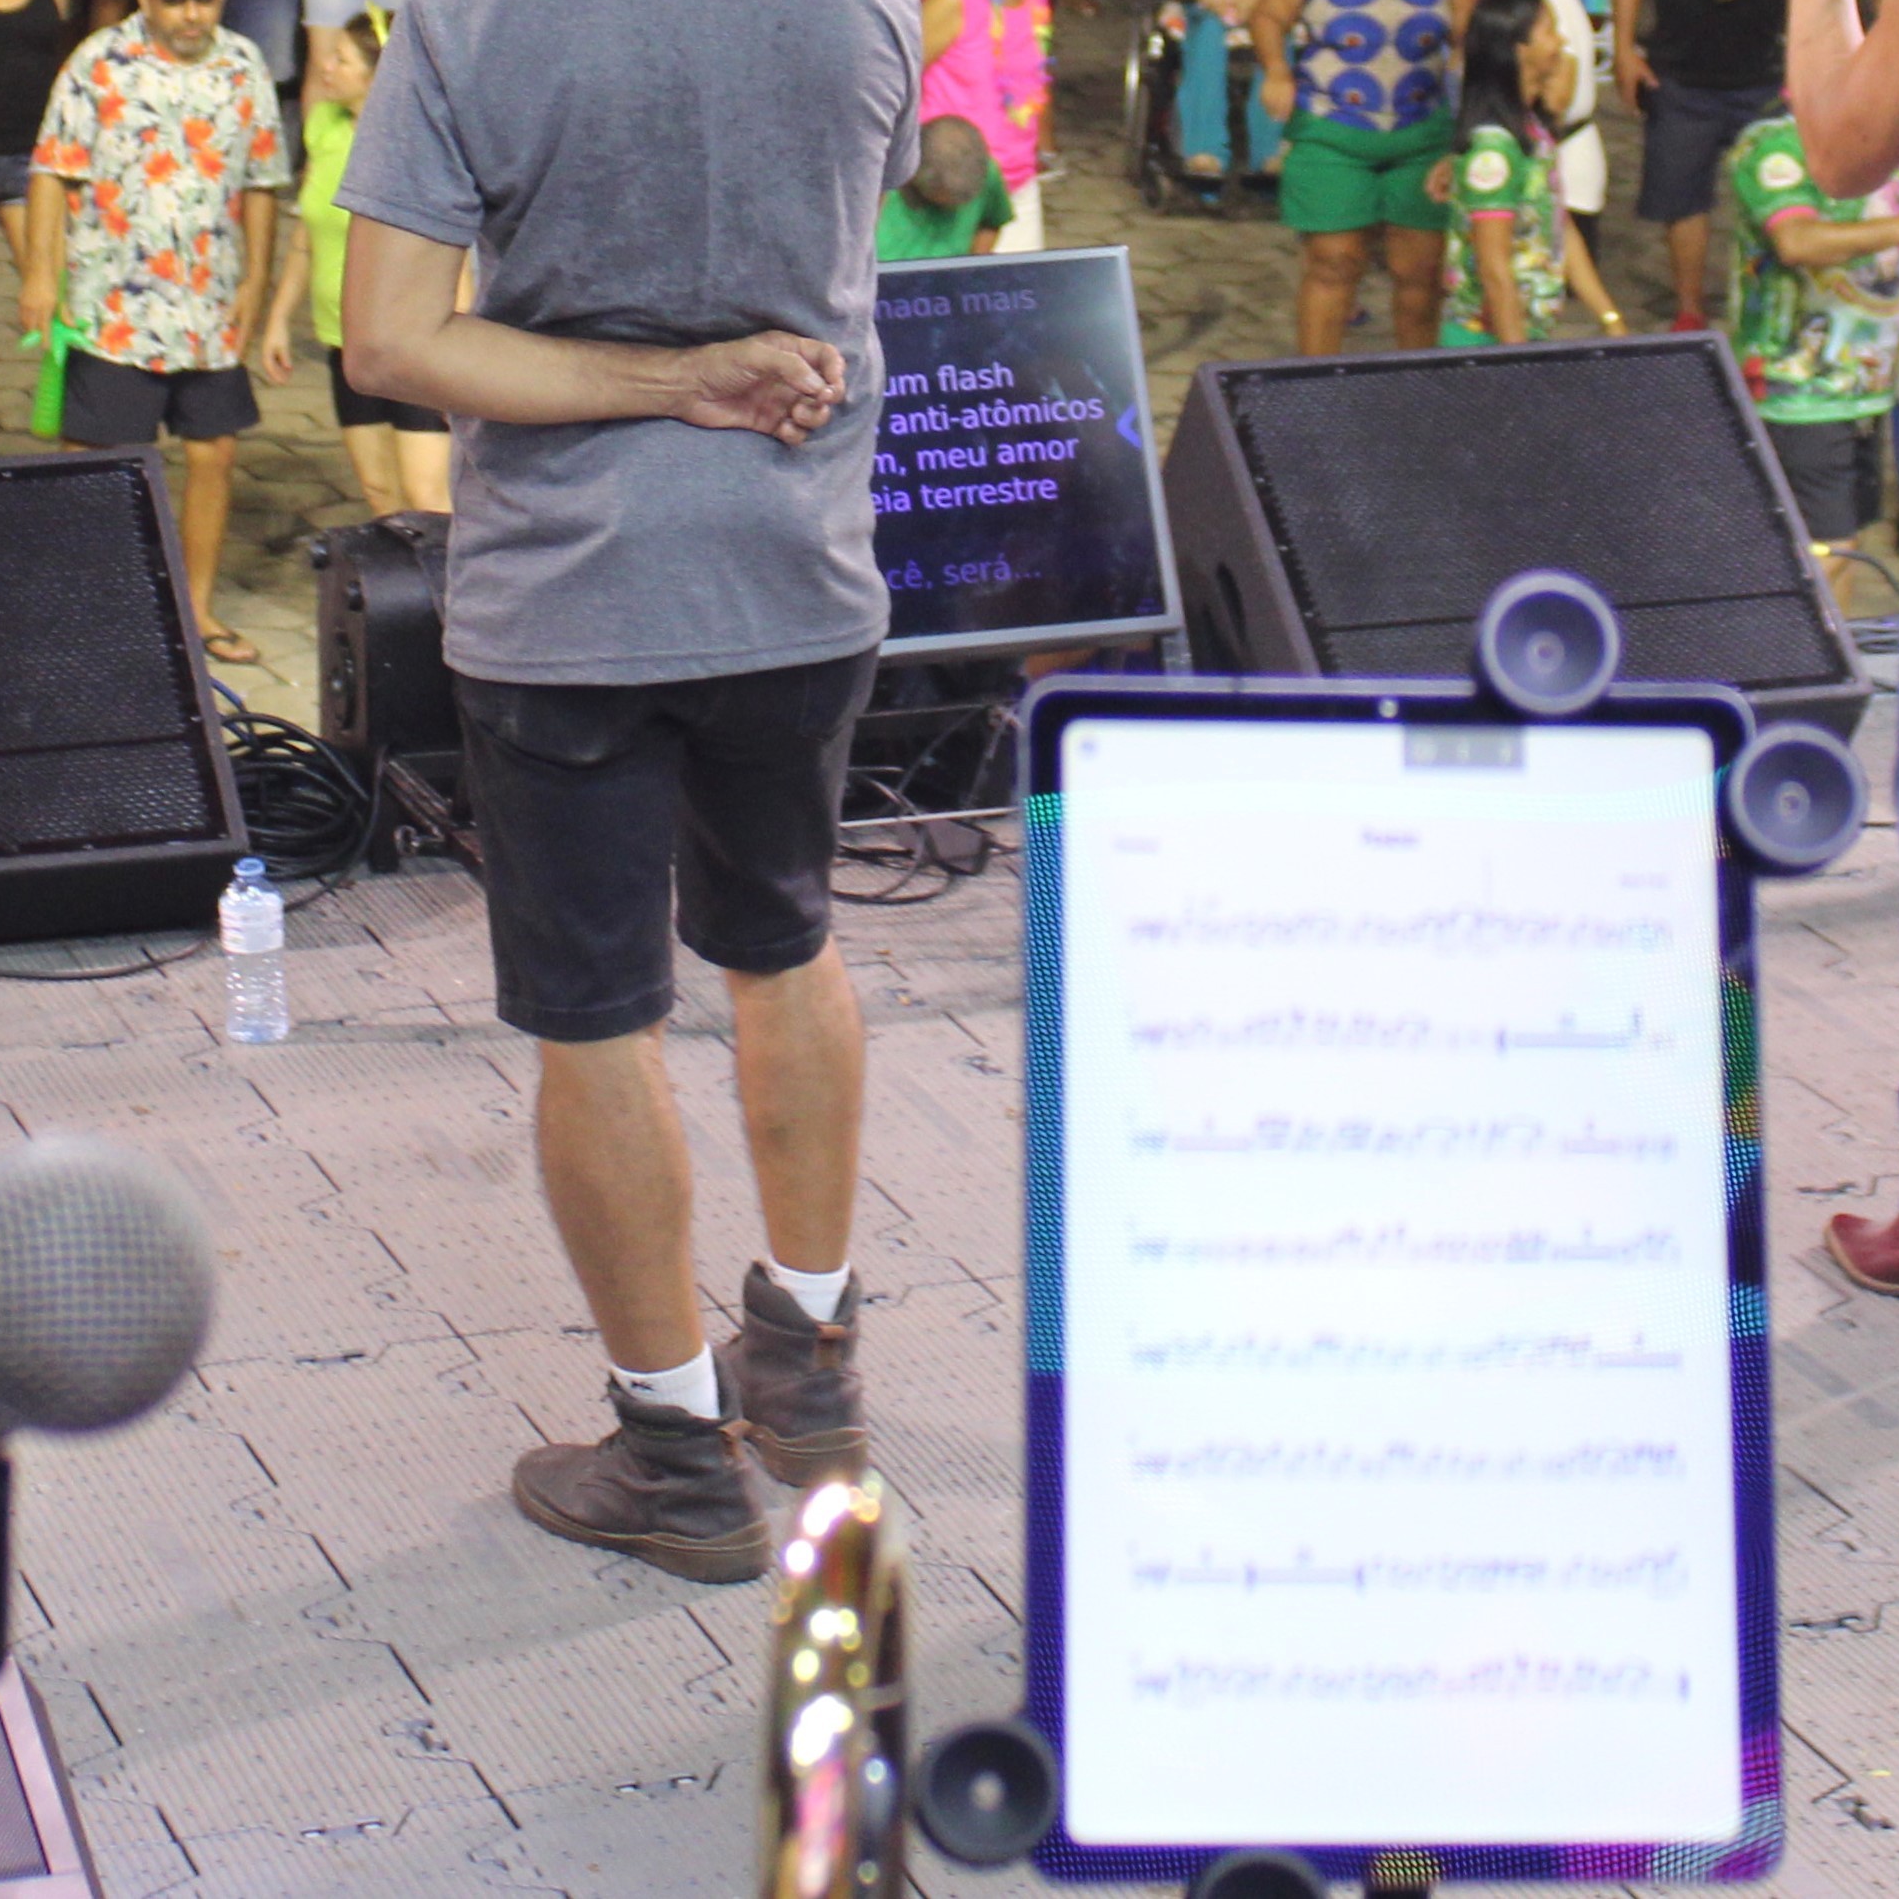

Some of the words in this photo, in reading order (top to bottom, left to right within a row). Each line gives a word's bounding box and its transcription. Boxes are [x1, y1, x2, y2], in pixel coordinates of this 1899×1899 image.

[962, 286, 1038, 310] mais
[937, 361, 1016, 393] flash
[889, 394, 1106, 436] anti-atômicos
[916, 443, 988, 472] meu
[996, 435, 1081, 465] amor
[920, 475, 1060, 510] terrestre
